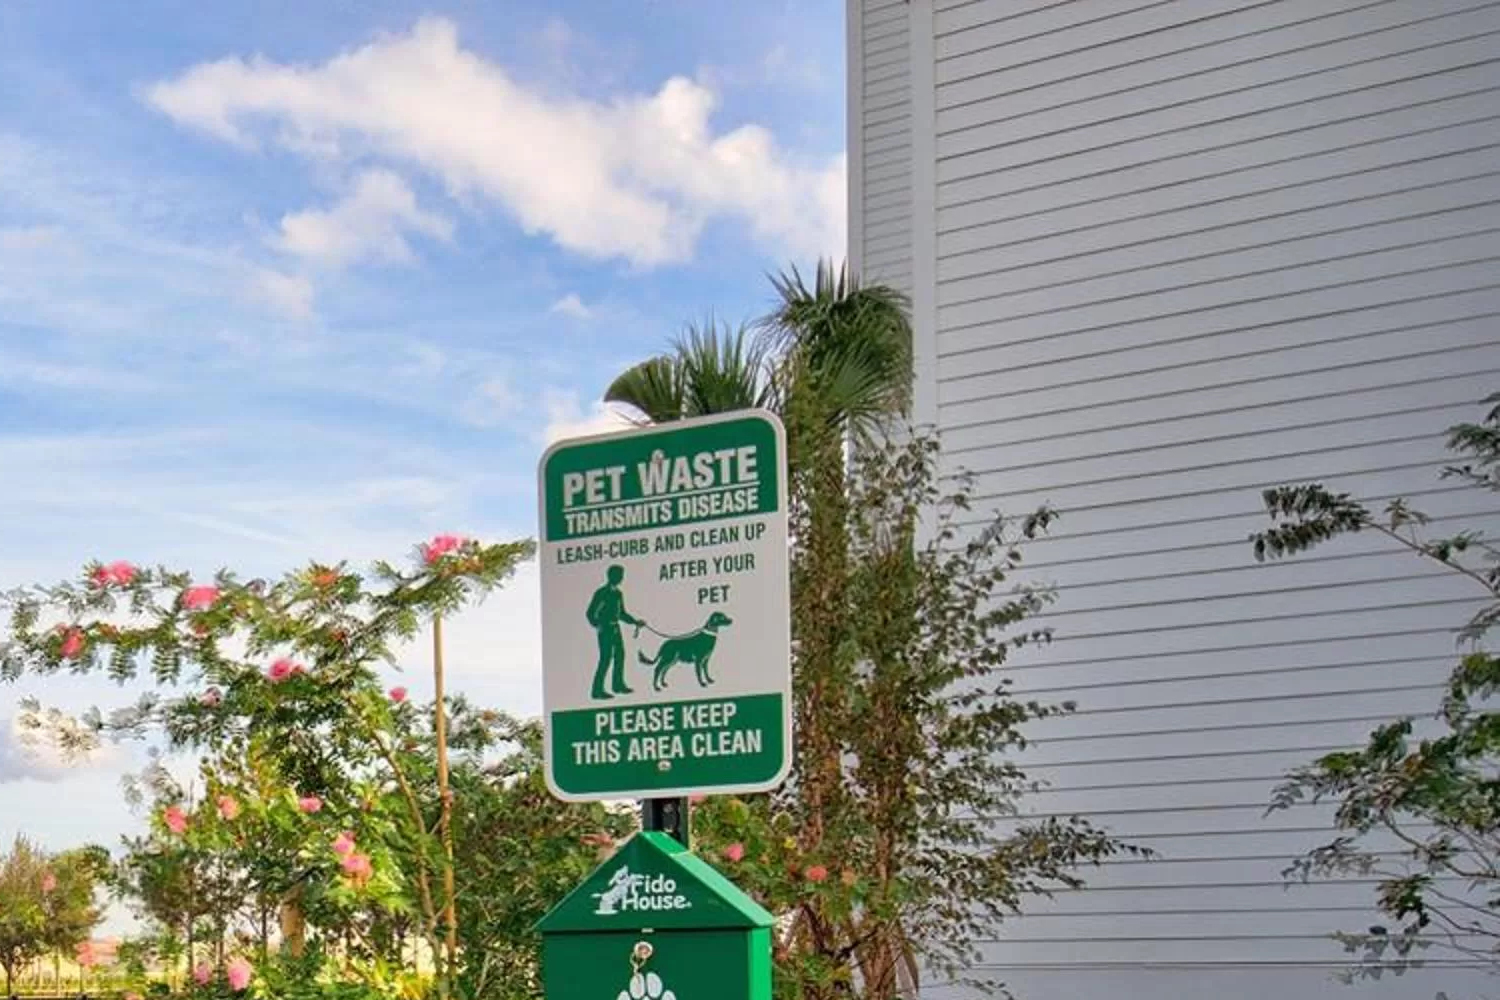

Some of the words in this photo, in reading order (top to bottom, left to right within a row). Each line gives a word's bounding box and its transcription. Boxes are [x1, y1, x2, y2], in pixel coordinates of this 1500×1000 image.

[563, 466, 626, 507] PET
[638, 446, 758, 496] WASTE
[564, 499, 672, 534] TRANSMITS
[678, 488, 759, 519] DISEASE
[557, 538, 649, 564] LEASH-CURB
[655, 534, 684, 553] AND
[690, 528, 739, 549] CLEAN
[745, 523, 766, 541] UP
[659, 560, 707, 581] AFTER
[712, 553, 755, 573] YOUR
[698, 585, 730, 604] PET
[595, 707, 675, 736] PLEASE
[682, 702, 737, 729] KEEP
[572, 741, 621, 765] THIS
[627, 735, 684, 761] AREA
[691, 729, 762, 757] CLEAN
[630, 873, 676, 894] Fido
